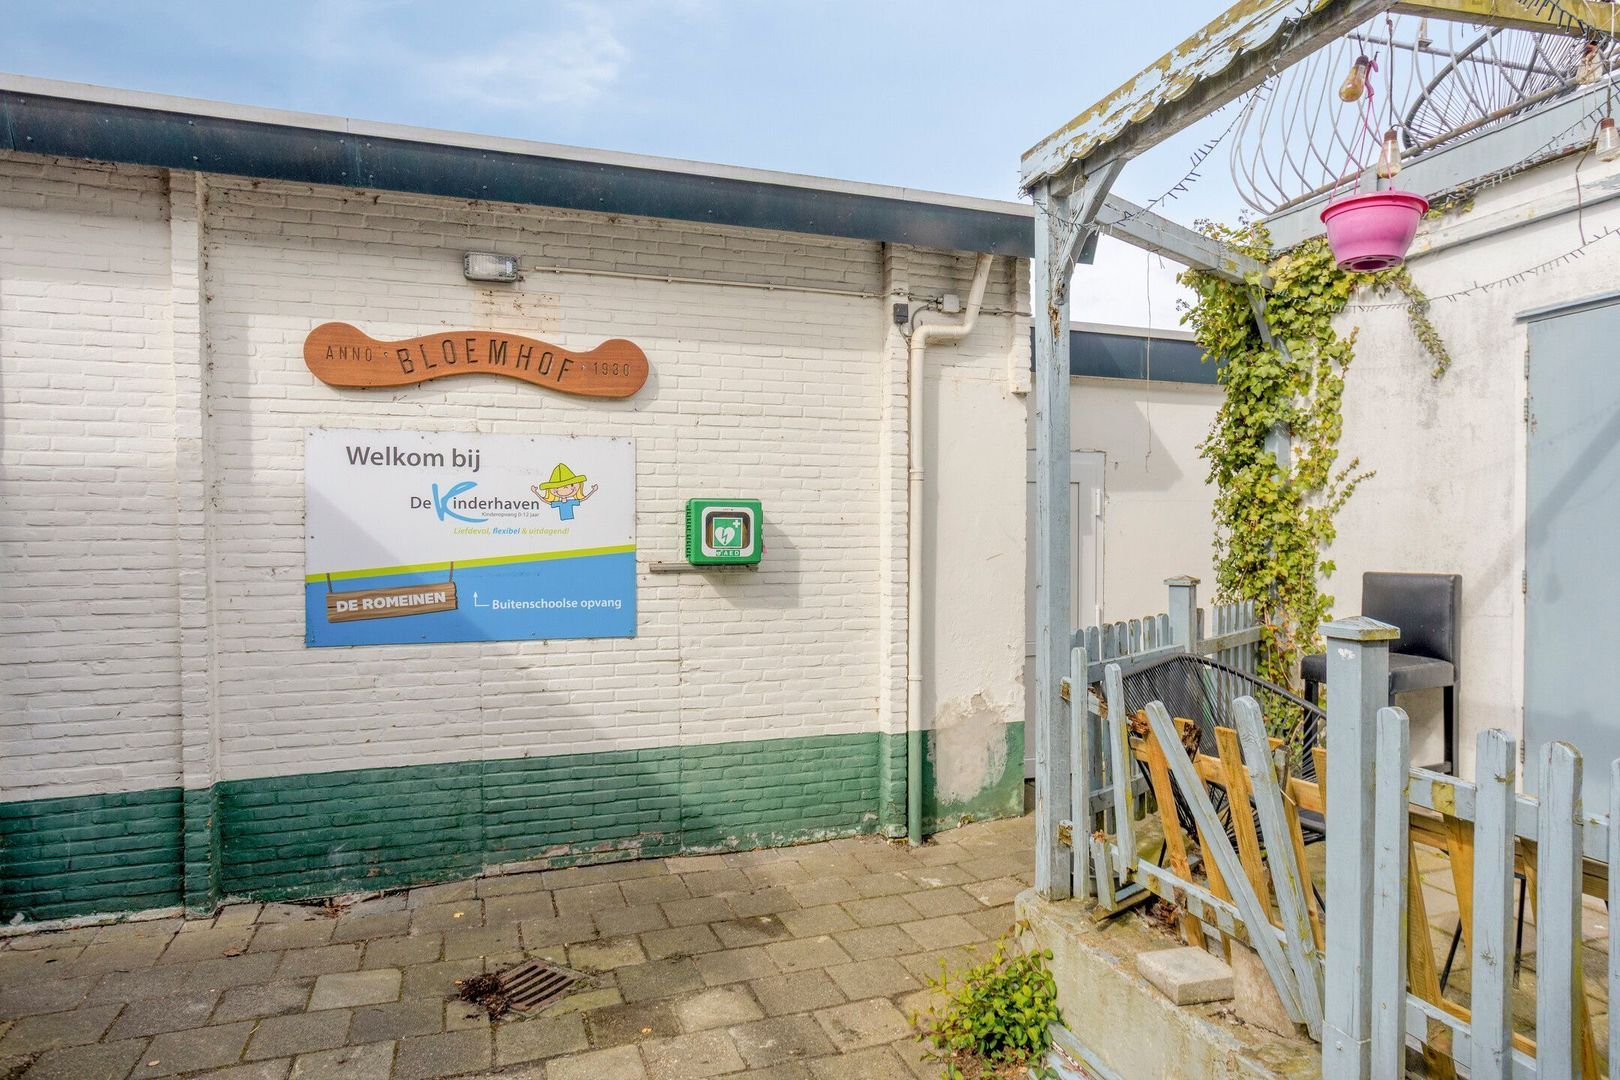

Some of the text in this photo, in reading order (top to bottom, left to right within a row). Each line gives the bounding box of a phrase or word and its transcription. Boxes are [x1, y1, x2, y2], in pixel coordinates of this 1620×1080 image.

[325, 345, 373, 362] ANNO
[396, 338, 574, 382] BLOEMHOF
[346, 446, 481, 472] Welkom bij
[410, 481, 540, 522] De Kinderhaven
[454, 527, 491, 536] Liefdevol,
[492, 527, 521, 535] flexibel
[528, 528, 570, 537] uitdagend!
[336, 591, 446, 613] DE ROMEINEN
[492, 597, 622, 612] Buitenschoolse opvang
